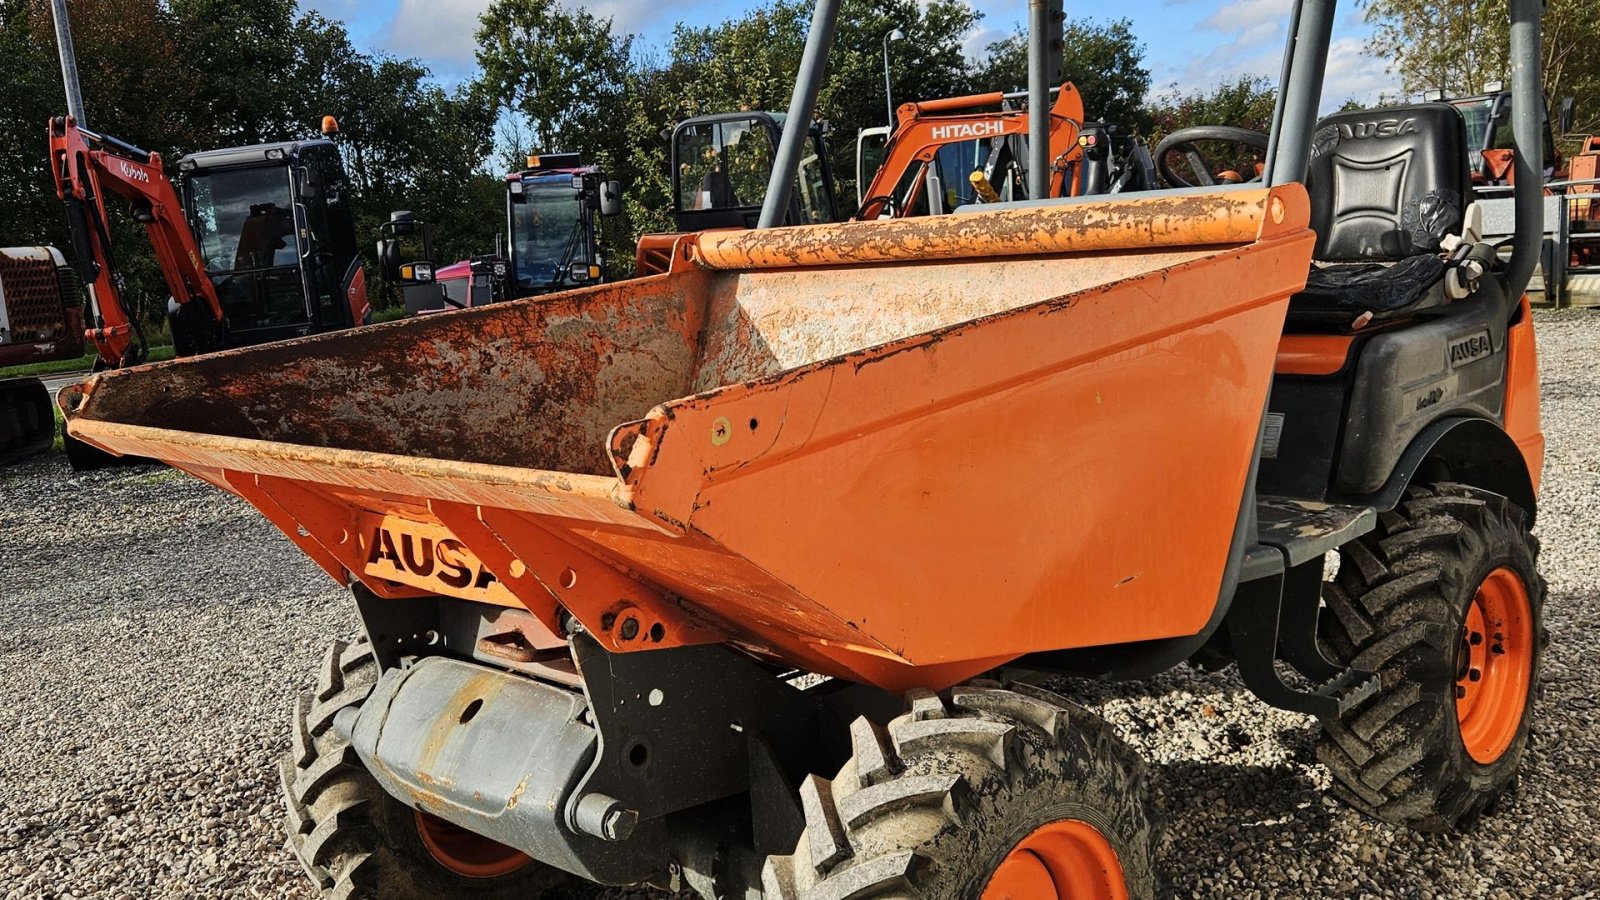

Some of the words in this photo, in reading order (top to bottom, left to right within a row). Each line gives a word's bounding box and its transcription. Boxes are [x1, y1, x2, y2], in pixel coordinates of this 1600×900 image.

[932, 120, 1004, 139] HITACHI
[120, 161, 149, 183] Kubota
[1451, 335, 1489, 363] AUSA
